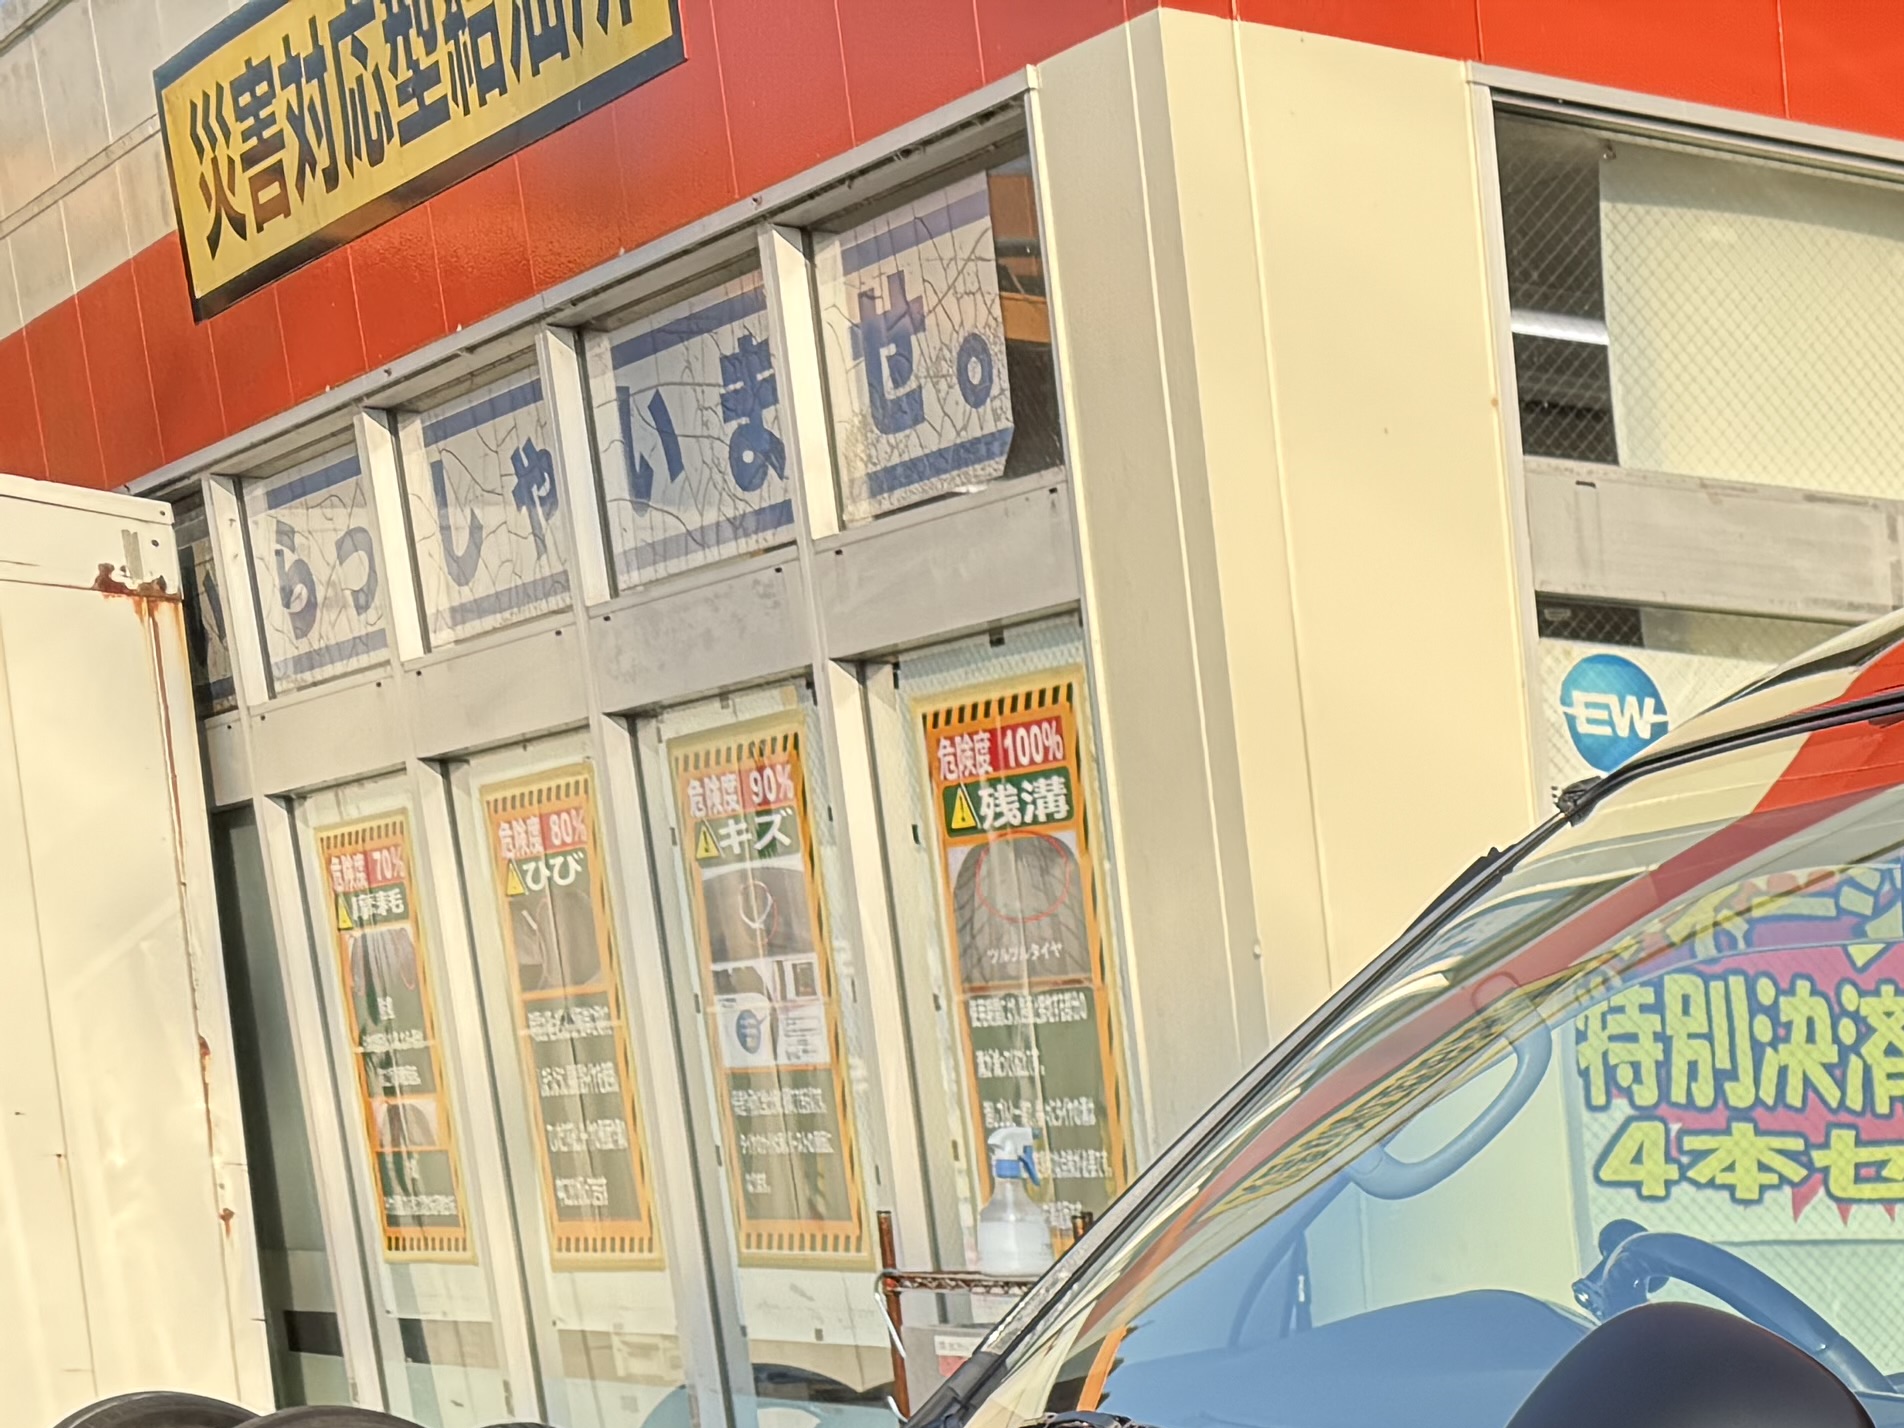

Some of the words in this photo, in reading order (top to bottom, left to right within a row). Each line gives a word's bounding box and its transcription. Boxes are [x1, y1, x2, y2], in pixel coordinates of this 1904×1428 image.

[1570, 689, 1657, 740] EW
[936, 730, 994, 781] 危険度
[1003, 720, 1064, 769] 100%
[749, 763, 795, 804] 90%
[977, 774, 1070, 831] 残溝
[548, 808, 588, 847] 80%
[717, 806, 793, 855] キズ
[371, 845, 406, 882] 70%
[521, 850, 584, 892] ひび
